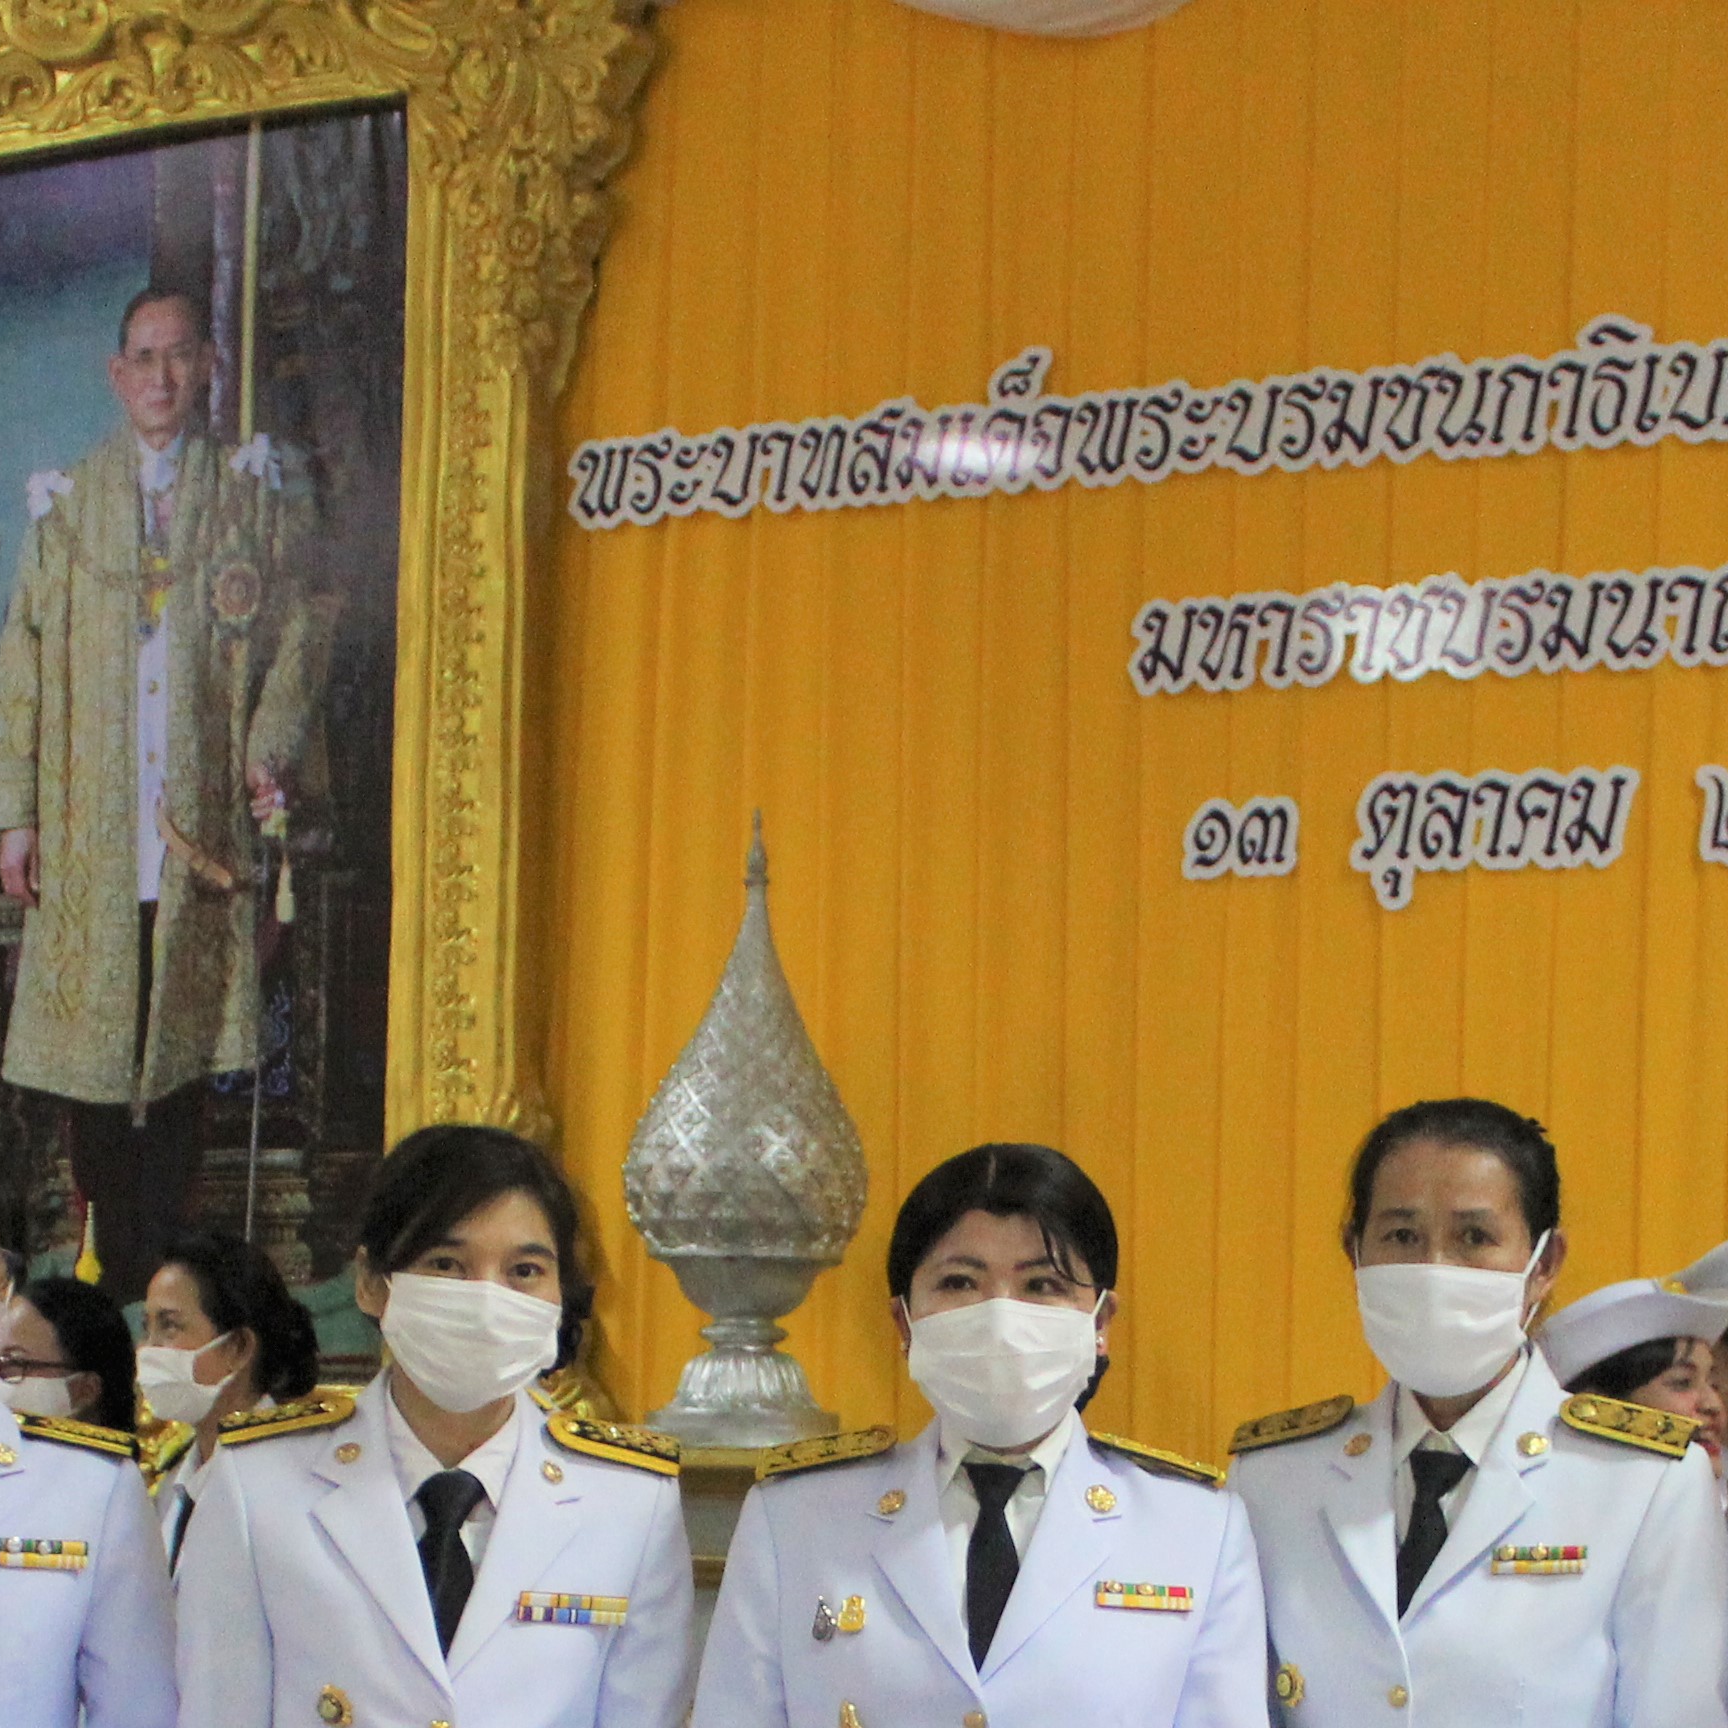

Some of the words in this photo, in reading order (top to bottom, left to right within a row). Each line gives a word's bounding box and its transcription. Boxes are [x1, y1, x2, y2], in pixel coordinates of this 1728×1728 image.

[1192, 804, 1290, 869] ๑๓
[1360, 775, 1628, 899] ตุลาคม
